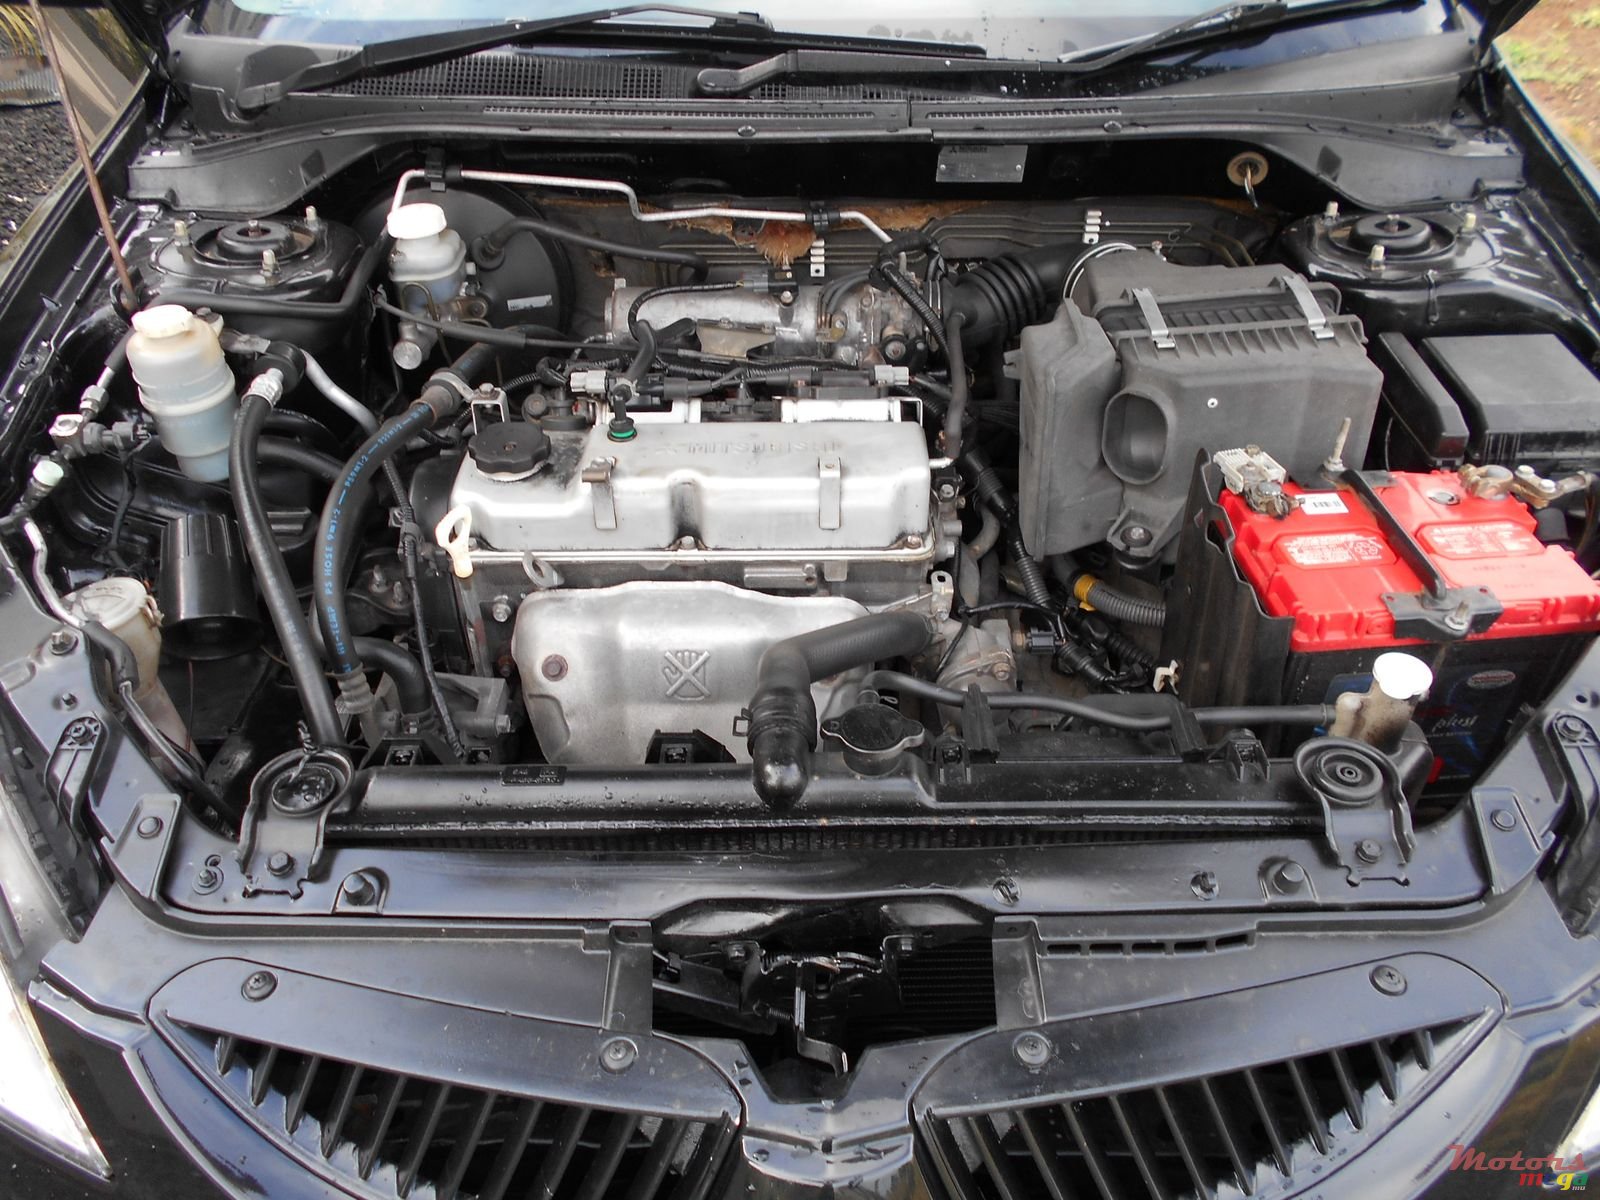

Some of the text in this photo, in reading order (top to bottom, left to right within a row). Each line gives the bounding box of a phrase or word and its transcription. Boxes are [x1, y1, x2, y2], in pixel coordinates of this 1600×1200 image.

[687, 441, 838, 454] MITSUBISHI
[323, 546, 334, 577] HOSE
[324, 582, 334, 596] PS
